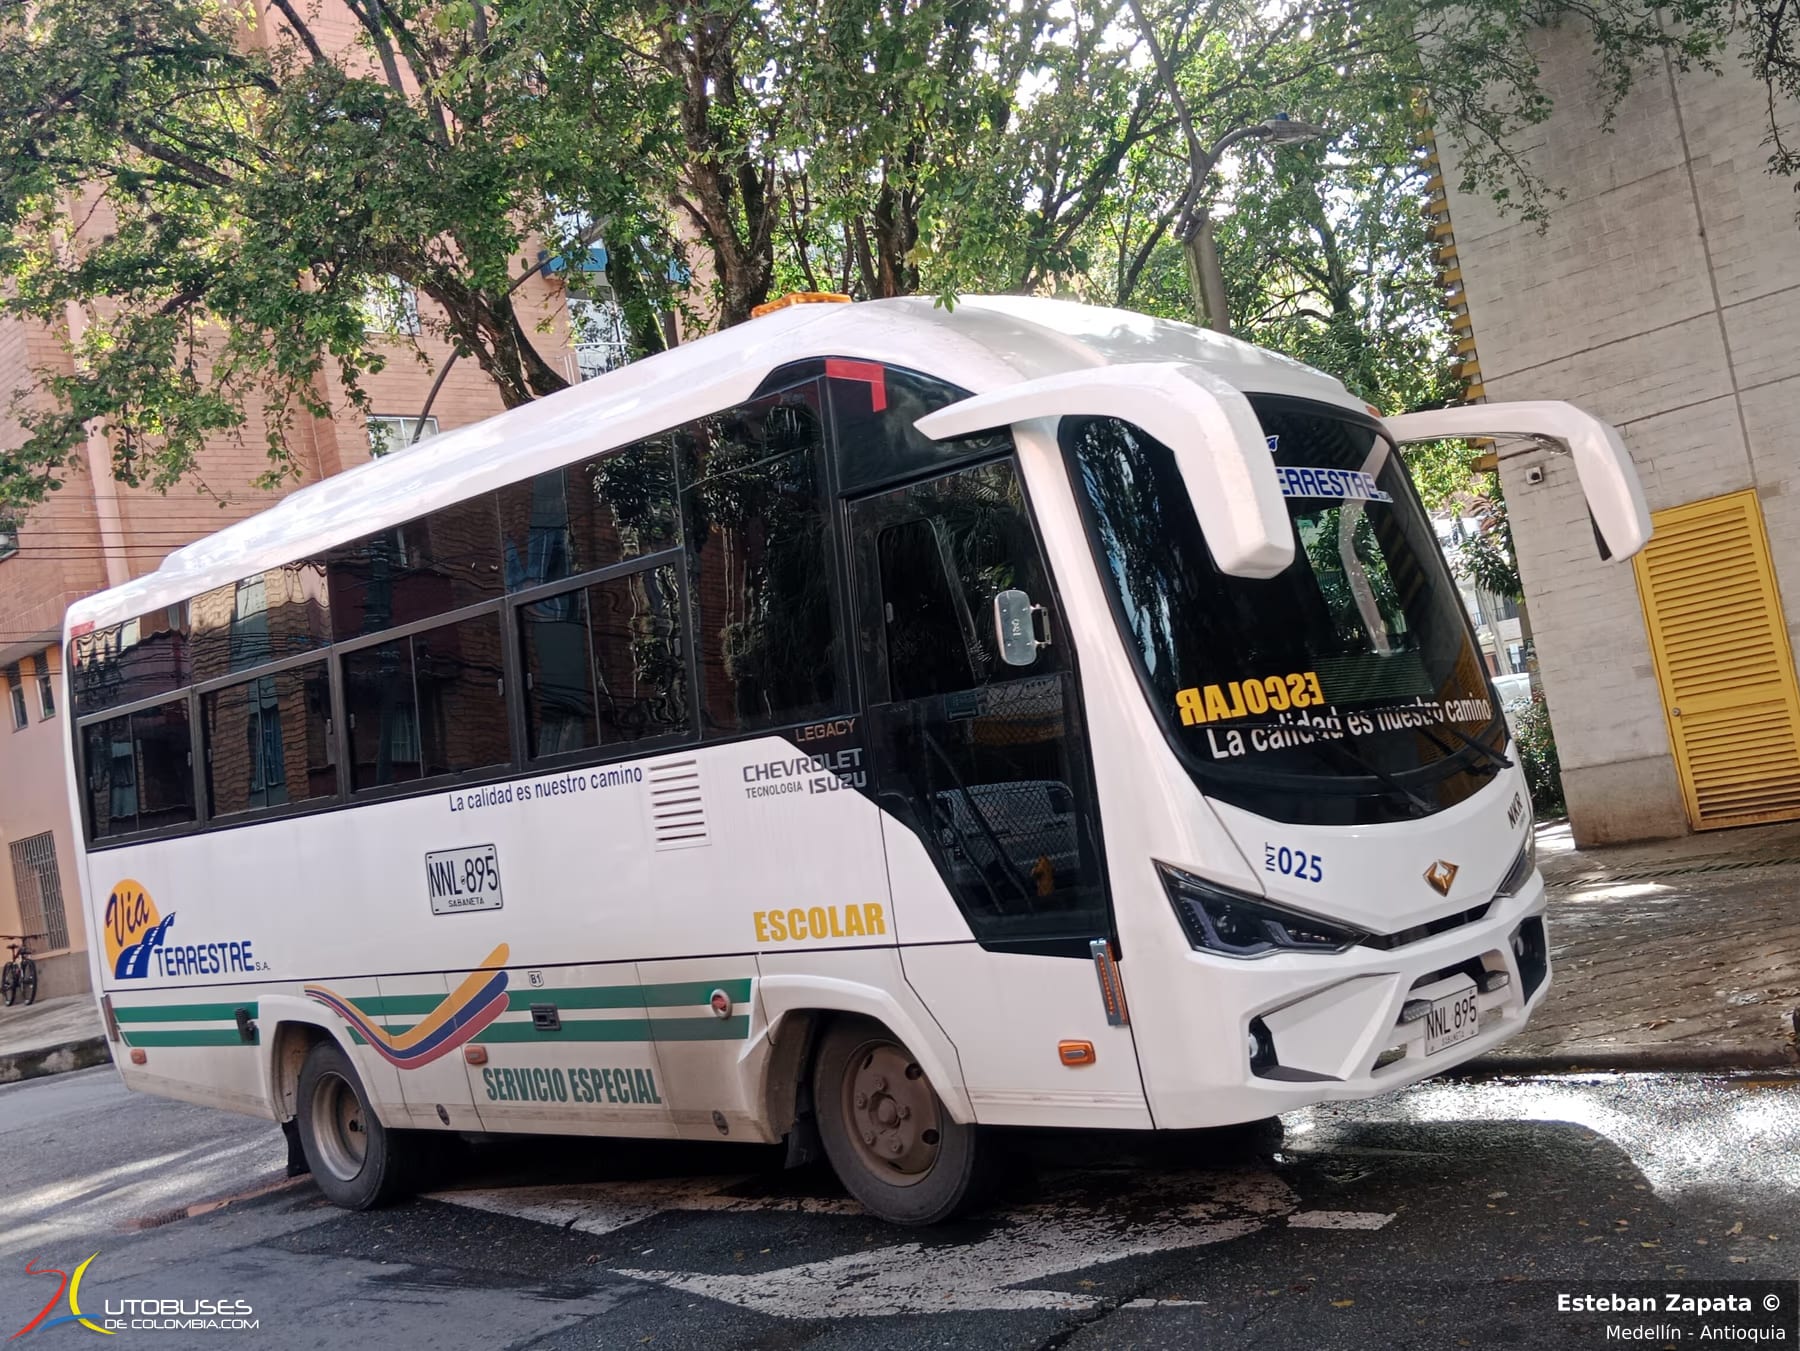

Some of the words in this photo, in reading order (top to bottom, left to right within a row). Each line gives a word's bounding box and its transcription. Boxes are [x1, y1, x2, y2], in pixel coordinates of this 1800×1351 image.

[1275, 468, 1380, 498] ERRESTRE
[795, 718, 856, 742] LEGACY
[1206, 728, 1246, 759] La
[1347, 711, 1375, 736] es
[1445, 692, 1493, 722] camino
[743, 748, 863, 782] CHEVROLET
[449, 794, 465, 812] La
[467, 784, 513, 810] calidad
[516, 784, 532, 801] es
[535, 774, 586, 799] nuestro
[590, 765, 643, 789] camino
[745, 781, 803, 799] TECNOLOGIA
[809, 771, 867, 794] ISUZU
[1507, 791, 1523, 830] NKR
[1265, 841, 1275, 872] INT
[1278, 846, 1322, 883] 025
[448, 897, 485, 907] SABANETA
[753, 902, 886, 942] ESCOLAR
[154, 941, 255, 977] TERRESTRE
[482, 1067, 568, 1103] SERVICIO
[567, 1068, 663, 1104] ESPECIAL
